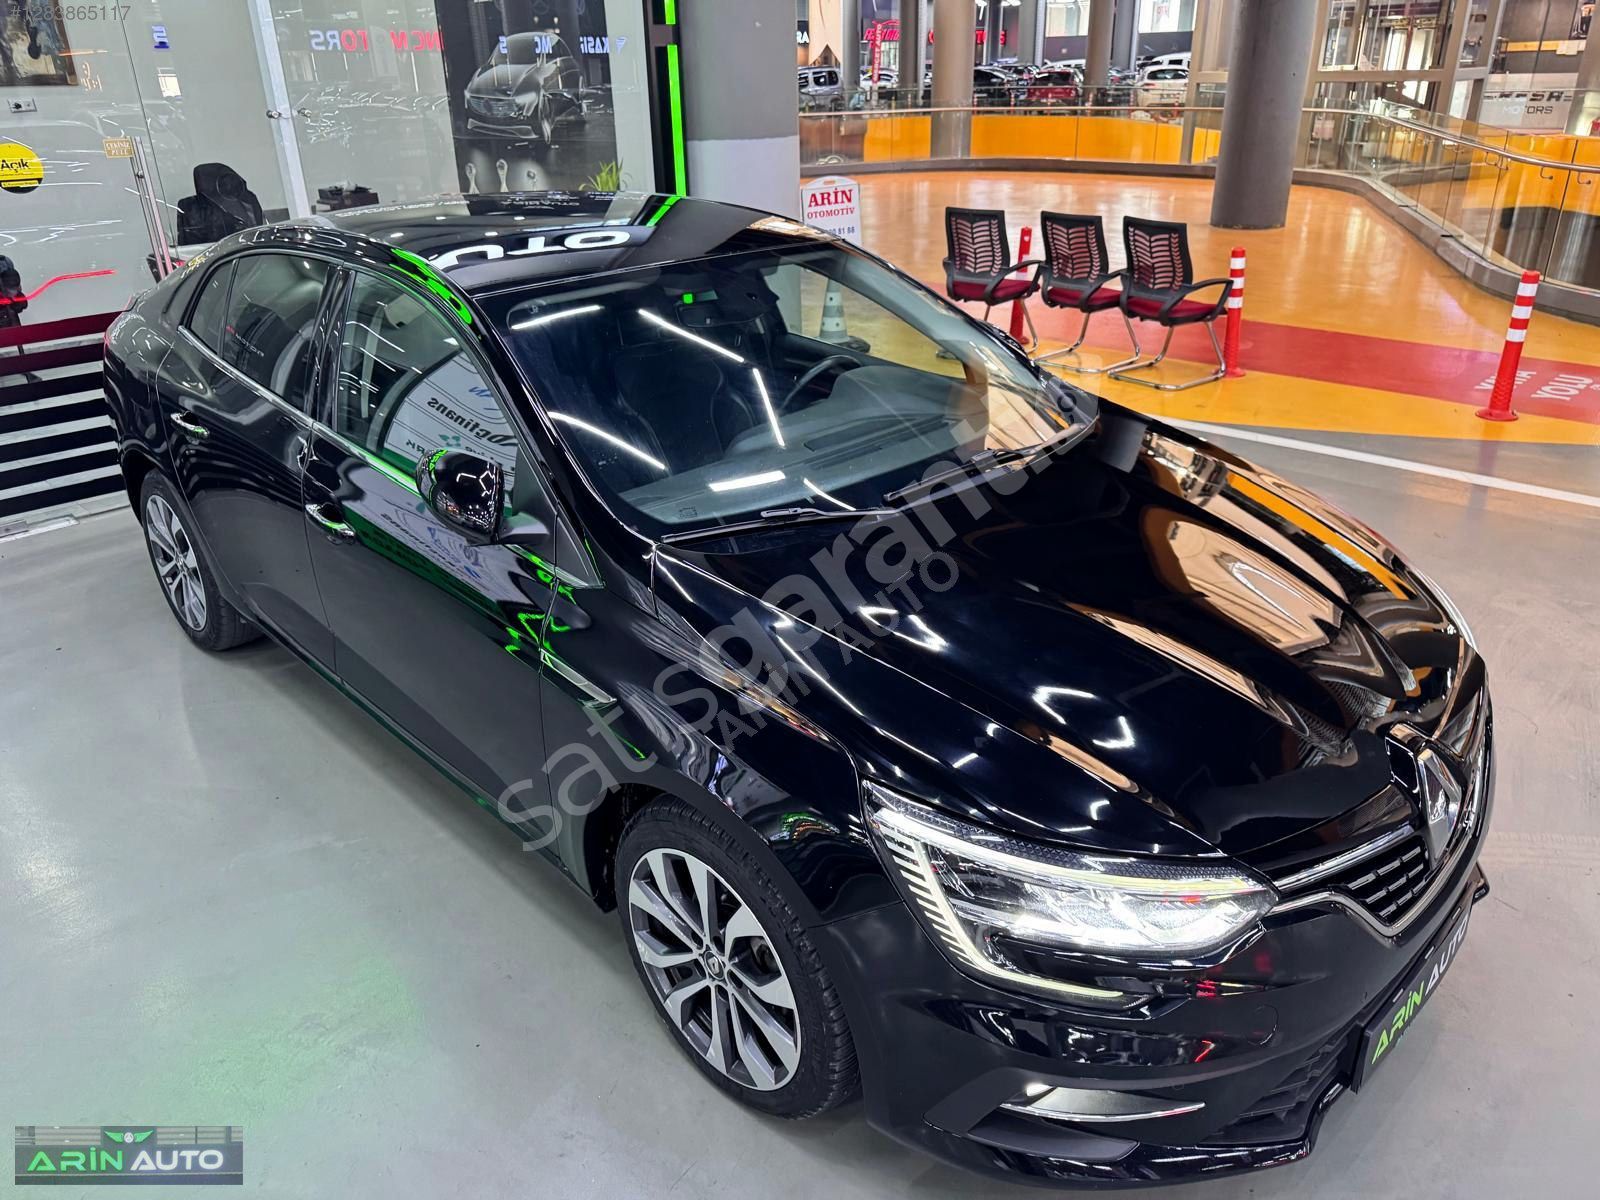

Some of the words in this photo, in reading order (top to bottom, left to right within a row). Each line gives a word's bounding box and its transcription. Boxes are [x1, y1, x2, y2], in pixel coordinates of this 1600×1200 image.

[0, 158, 30, 173] Açık
[808, 187, 853, 208] ARİN
[807, 205, 856, 220] OTOMOTİV
[1530, 373, 1594, 401] YOLU
[1425, 913, 1469, 996] AUTO
